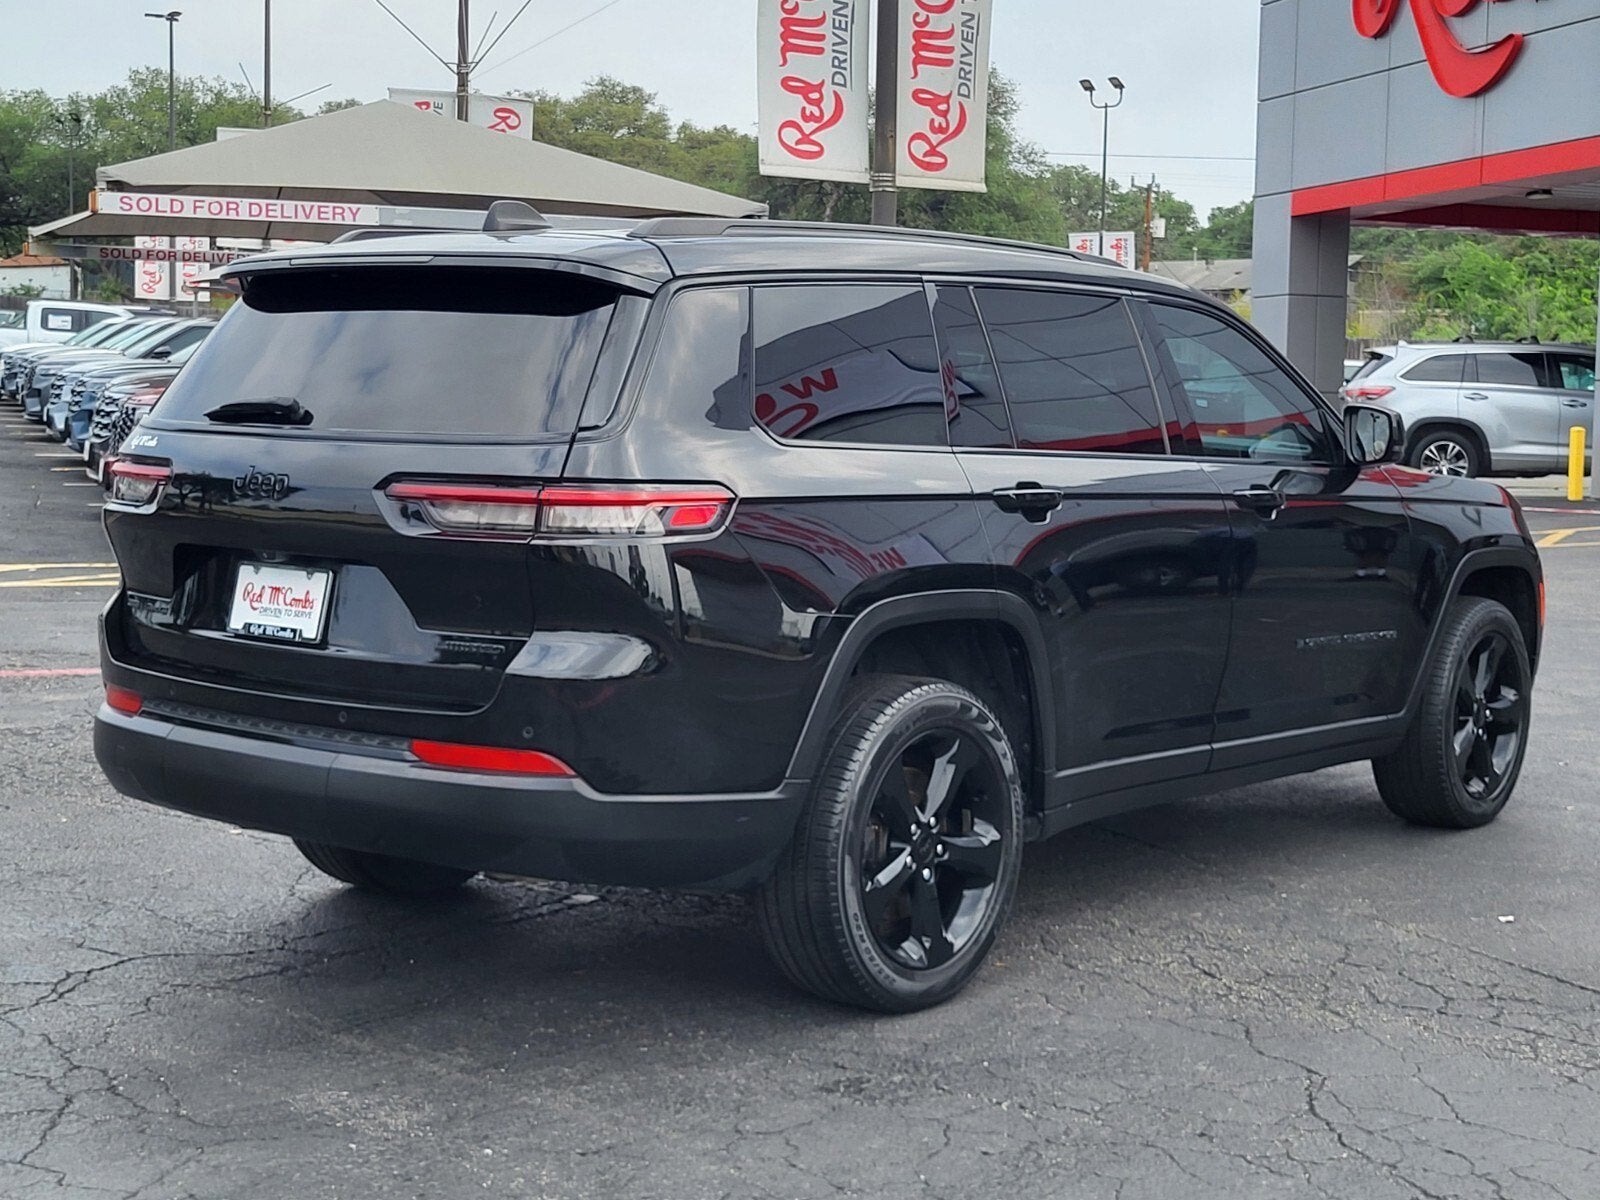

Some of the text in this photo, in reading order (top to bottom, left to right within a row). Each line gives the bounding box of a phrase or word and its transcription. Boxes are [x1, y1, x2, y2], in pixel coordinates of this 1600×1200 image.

[832, 0, 849, 88] DRIVEN
[957, 13, 975, 99] DRIVEN
[778, 0, 844, 160] Red Mc
[907, 88, 967, 172] Red
[119, 196, 362, 222] SOLD FOR DELIVERY
[100, 248, 251, 263] SOLD FOR DELIVER
[232, 465, 290, 500] Jeep
[242, 581, 315, 611] Red McCombs
[259, 606, 313, 619] DRIVEN TO SERVE
